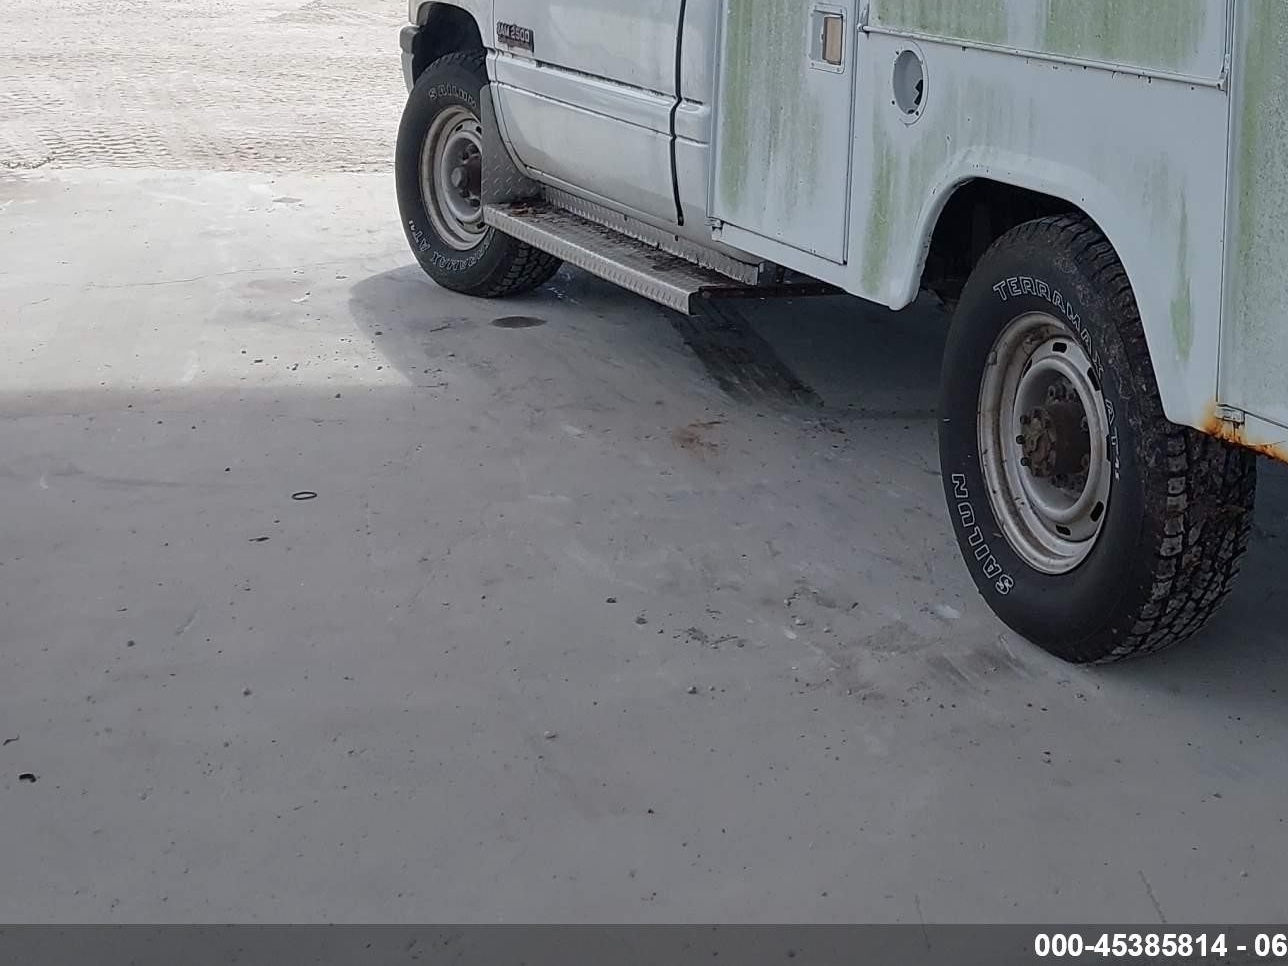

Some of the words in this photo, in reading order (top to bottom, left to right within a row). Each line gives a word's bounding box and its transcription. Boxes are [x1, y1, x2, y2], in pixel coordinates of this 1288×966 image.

[510, 25, 530, 43] 2500
[992, 276, 1105, 380] TERRAMAX
[951, 473, 1014, 595] SAILUN
